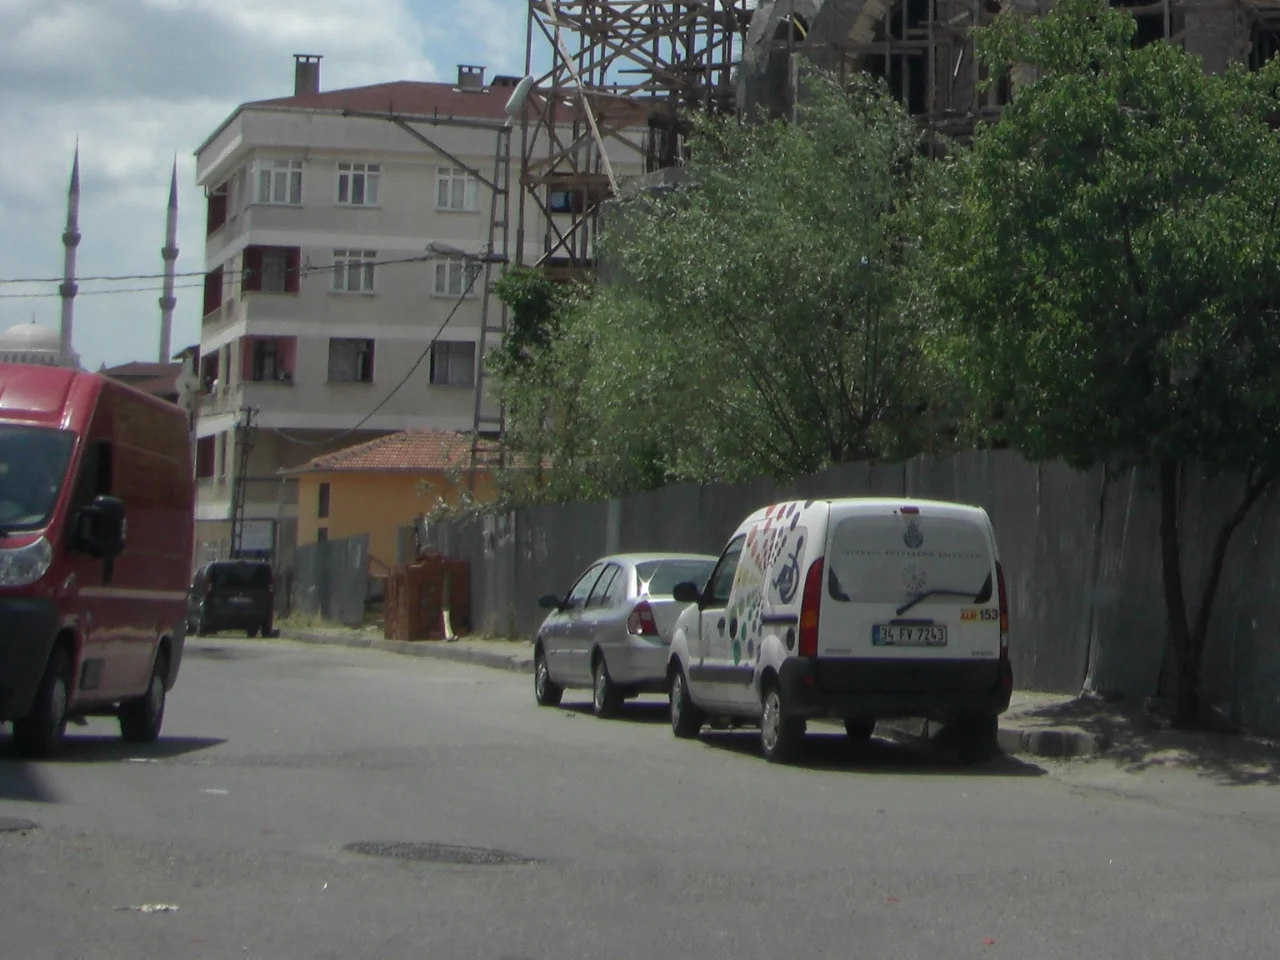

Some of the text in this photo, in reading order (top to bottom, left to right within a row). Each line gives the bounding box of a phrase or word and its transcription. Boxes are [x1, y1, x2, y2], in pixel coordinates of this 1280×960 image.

[980, 609, 999, 621] 153
[881, 627, 894, 641] 34
[917, 627, 944, 641] 7243
